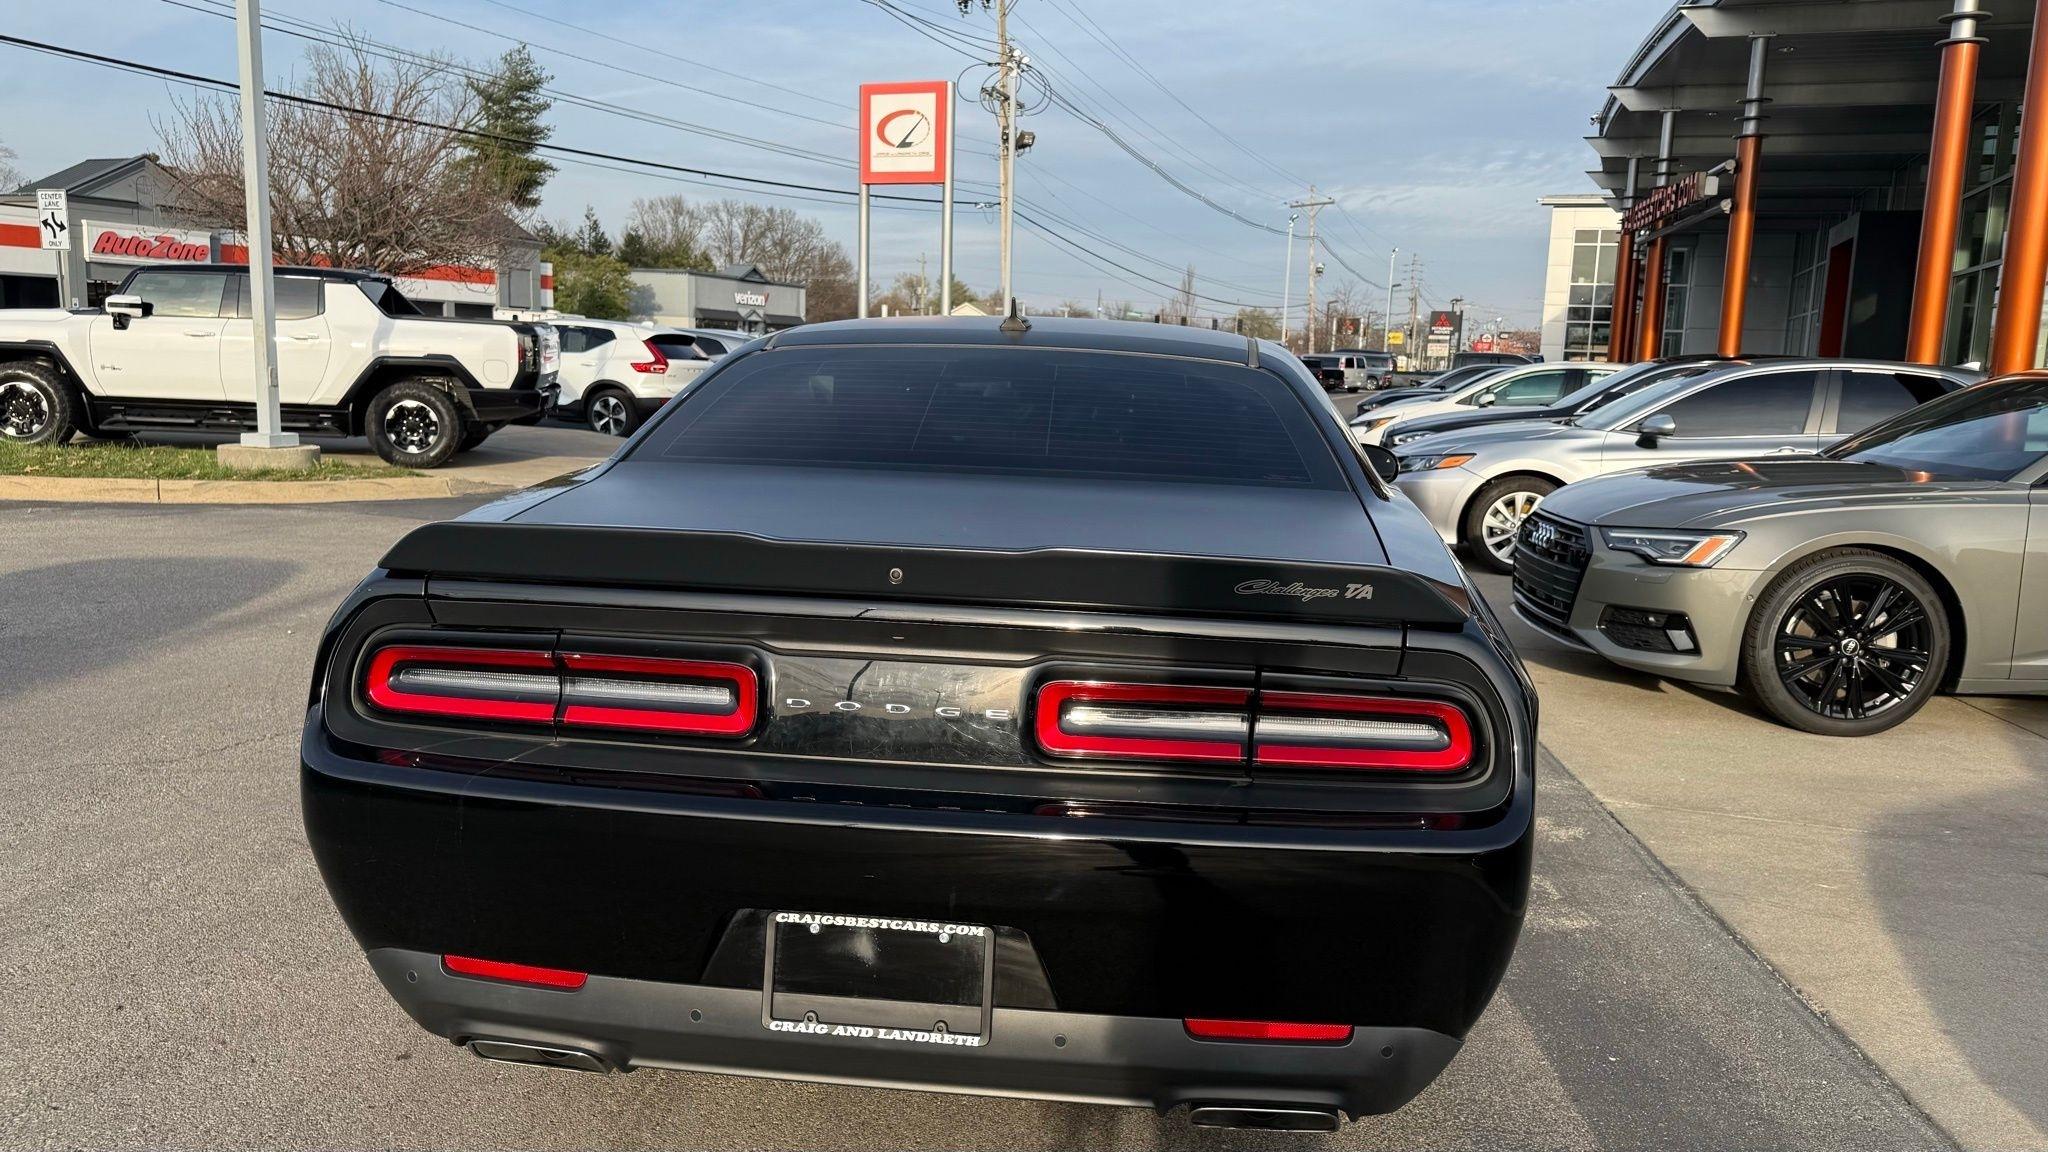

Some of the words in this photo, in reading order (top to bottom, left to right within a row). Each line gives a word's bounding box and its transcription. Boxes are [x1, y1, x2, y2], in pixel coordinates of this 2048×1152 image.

[92, 231, 209, 261] AutoZone
[734, 290, 766, 306] verizon
[1234, 579, 1340, 602] Challenger
[786, 698, 1010, 720] DODGE
[775, 912, 986, 937] CRAIGSBESTCARS.COM
[769, 1020, 829, 1035] CRAIG
[831, 1025, 874, 1038] AND
[877, 1028, 981, 1047] LANDRETH
